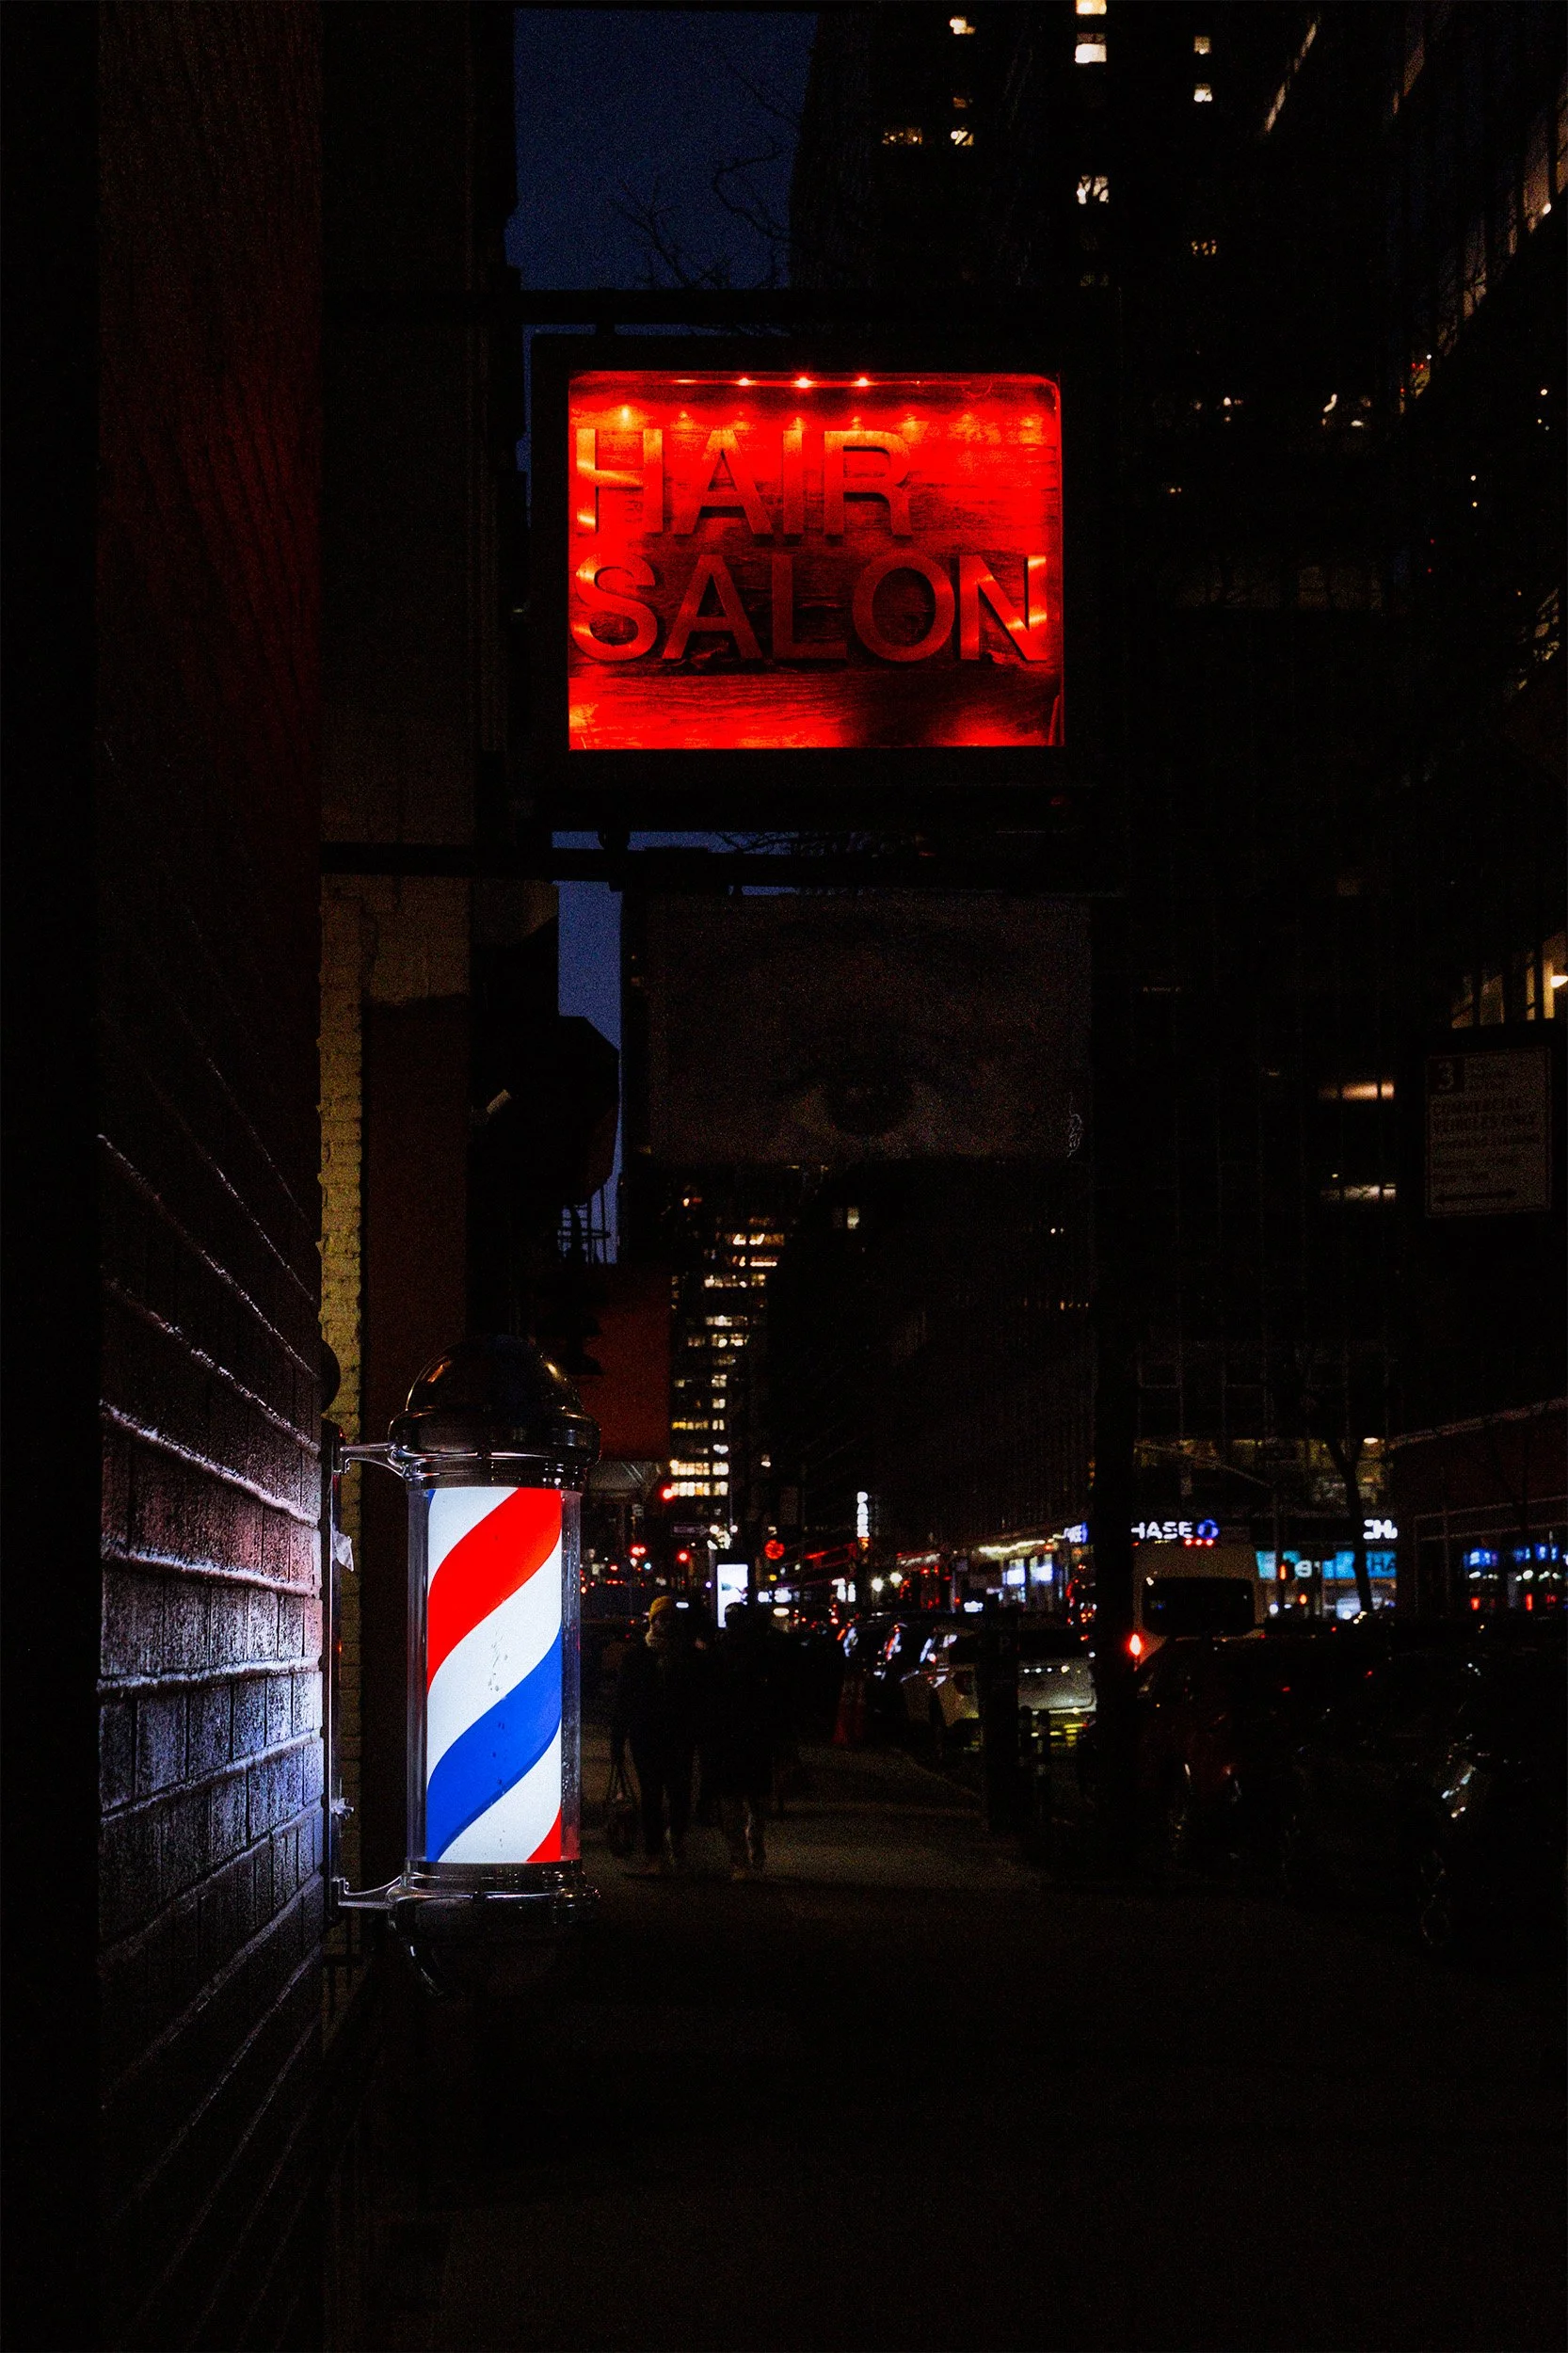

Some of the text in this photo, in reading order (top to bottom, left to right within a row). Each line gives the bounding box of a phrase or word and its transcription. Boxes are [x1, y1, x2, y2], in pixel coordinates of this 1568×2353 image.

[575, 428, 913, 536] HAIR
[571, 551, 1048, 663] SALON
[1437, 1062, 1454, 1090] 3
[1130, 1521, 1193, 1540] HASE
